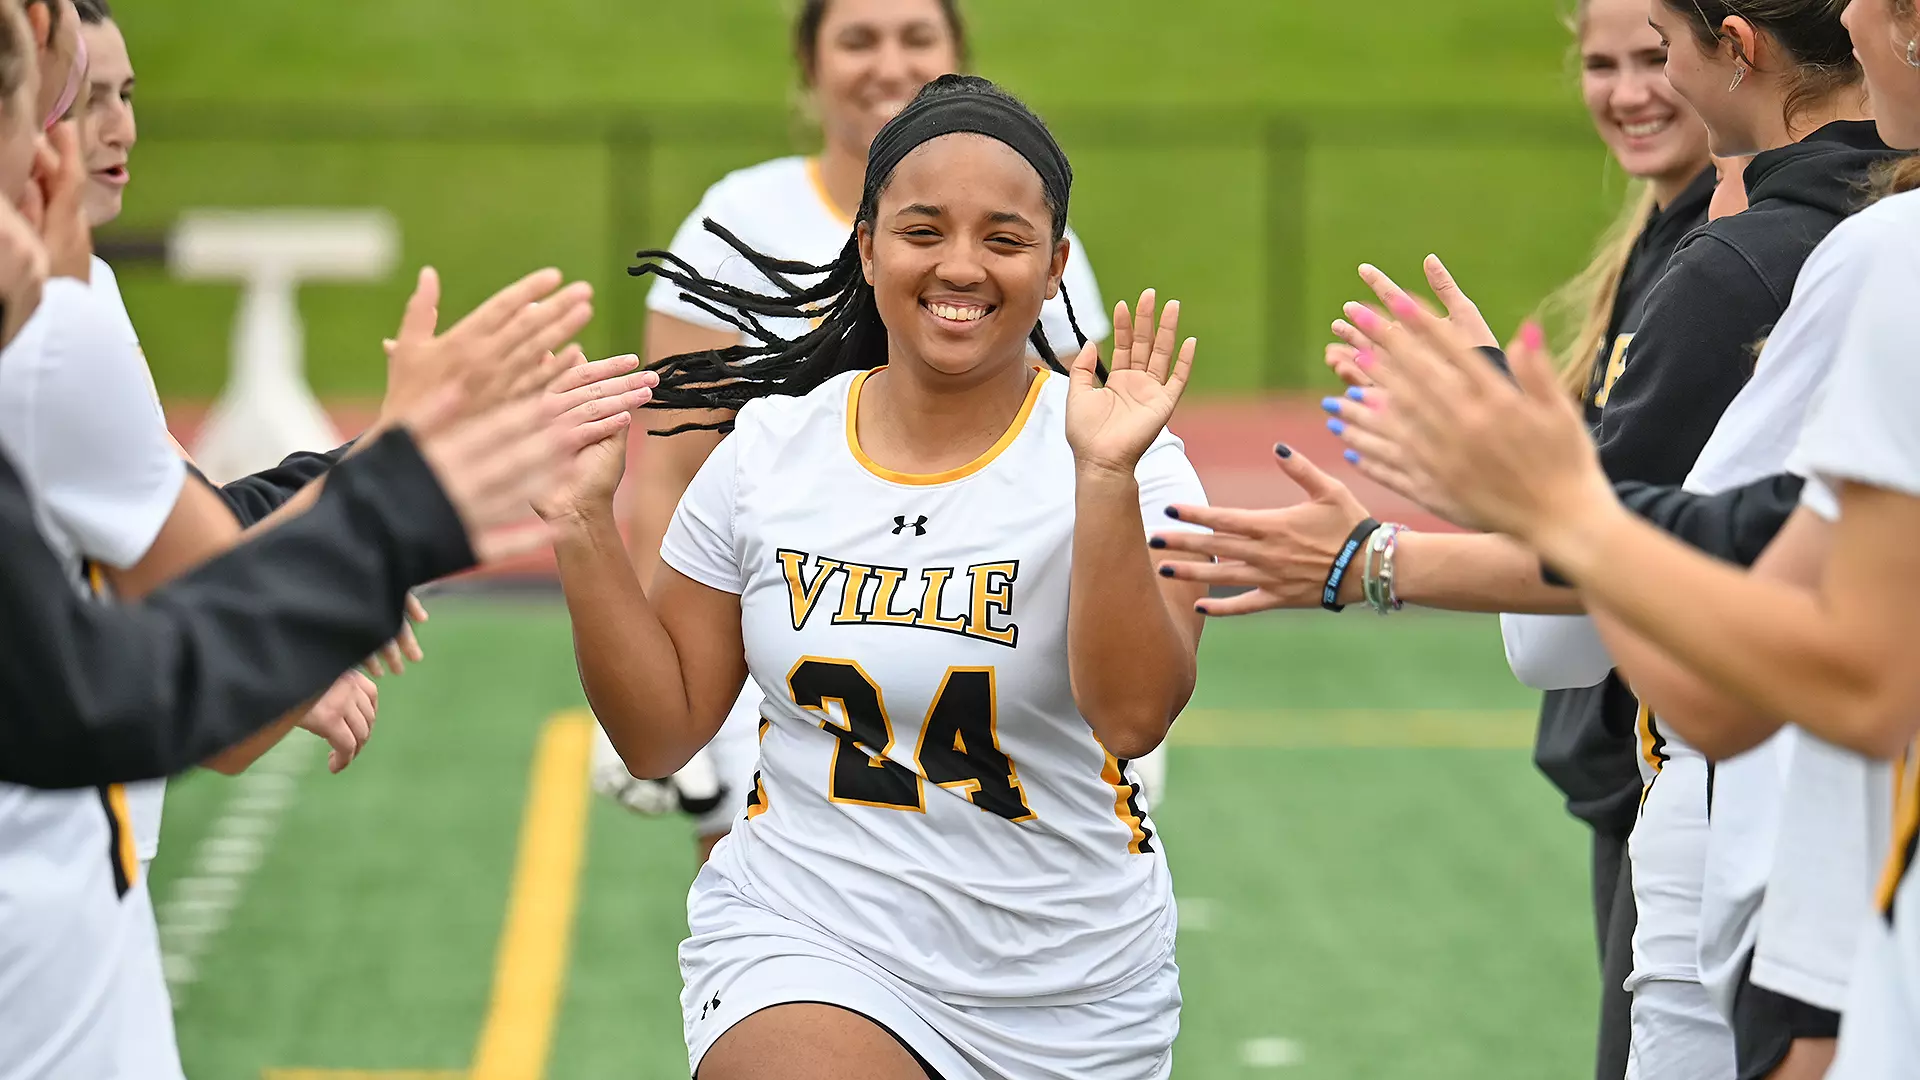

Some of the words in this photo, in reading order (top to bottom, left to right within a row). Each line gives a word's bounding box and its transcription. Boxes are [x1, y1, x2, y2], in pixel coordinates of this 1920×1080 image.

[776, 548, 1020, 649] VILLE
[1335, 539, 1358, 568] Sports
[785, 655, 1038, 823] 24
